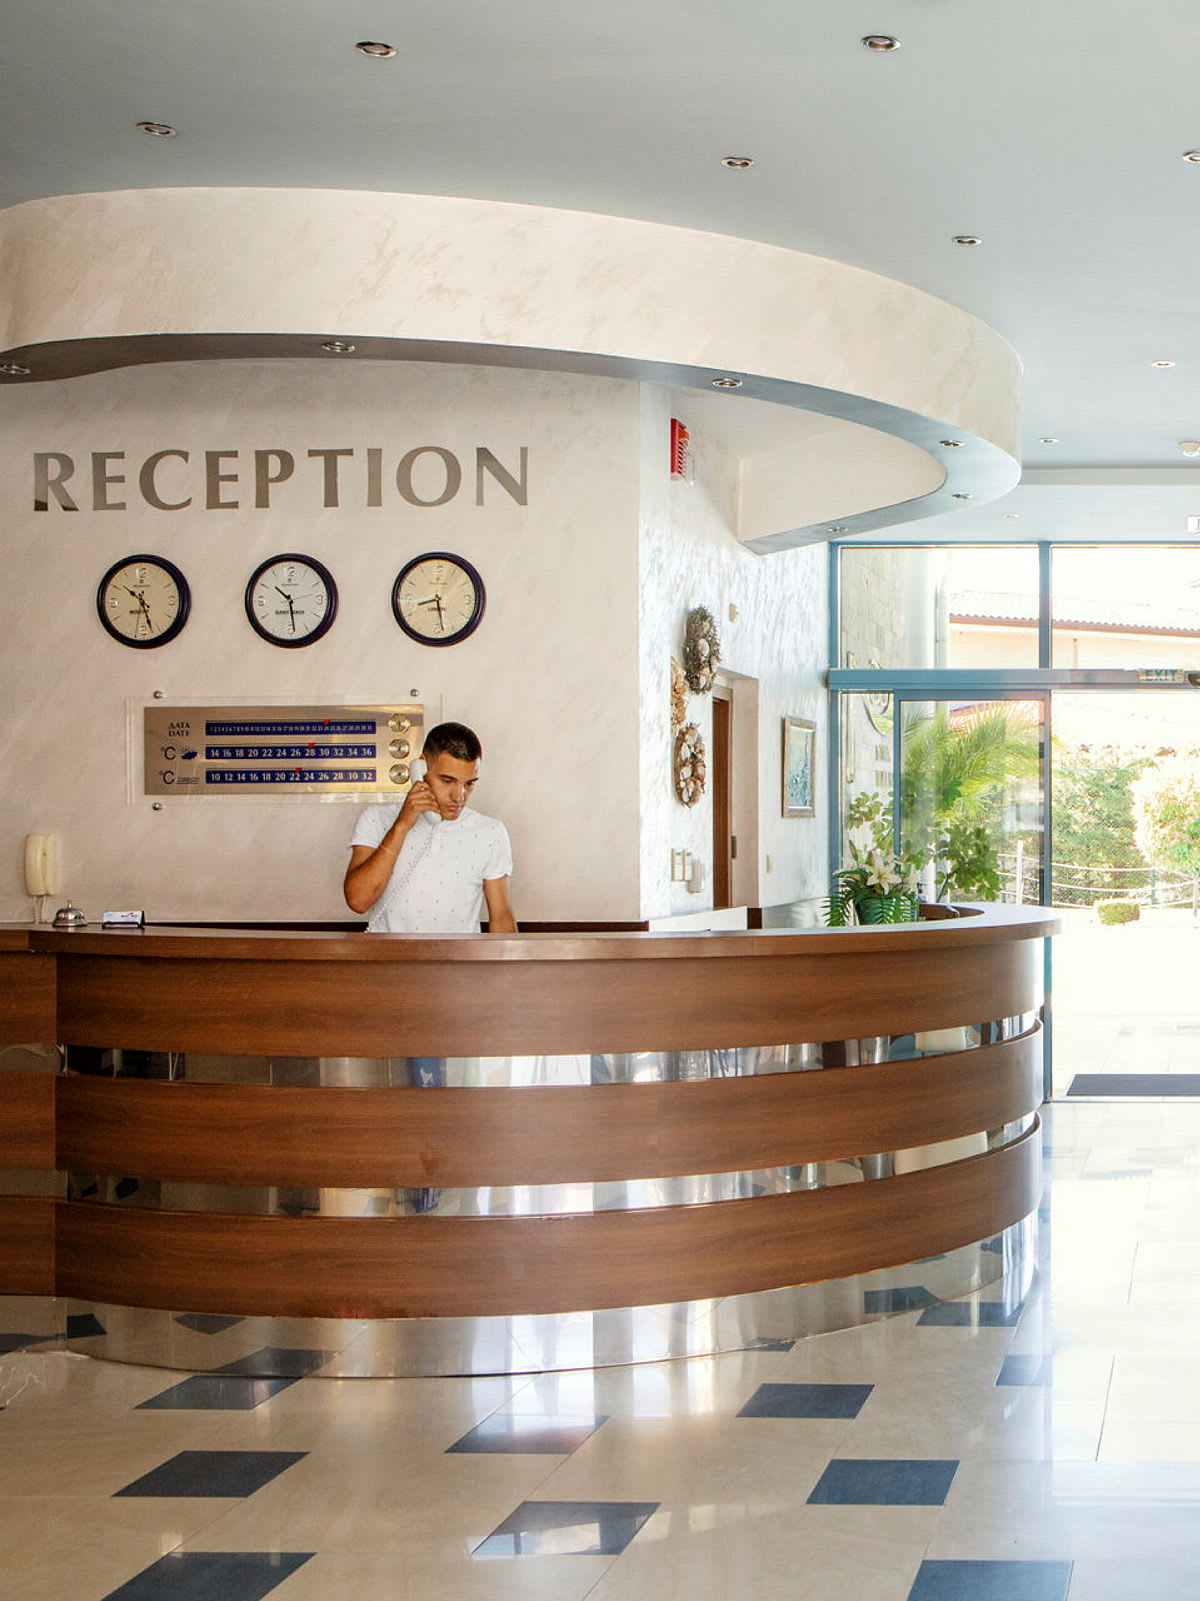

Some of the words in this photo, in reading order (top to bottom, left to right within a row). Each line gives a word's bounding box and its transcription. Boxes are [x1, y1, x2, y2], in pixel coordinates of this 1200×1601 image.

[34, 446, 528, 512] RECEPTION
[1145, 669, 1177, 681] EXIT
[211, 749, 219, 757] 14
[248, 749, 258, 757] 20
[262, 749, 273, 757] 22
[276, 749, 287, 757] 24
[290, 748, 300, 756] 26
[304, 748, 316, 756] 28
[320, 748, 330, 756] 30
[333, 748, 344, 756] 32
[348, 748, 358, 756] 34
[362, 748, 372, 756] 36
[211, 773, 220, 781] 10
[225, 773, 233, 781] 12
[237, 773, 246, 781] 14
[249, 773, 259, 781] 16
[262, 773, 271, 781] 18
[275, 773, 286, 781] 20
[289, 772, 300, 781] 22
[304, 772, 314, 781] 24
[319, 772, 329, 781] 26
[333, 772, 344, 781] 28
[347, 772, 358, 781] 30
[362, 772, 372, 781] 32
